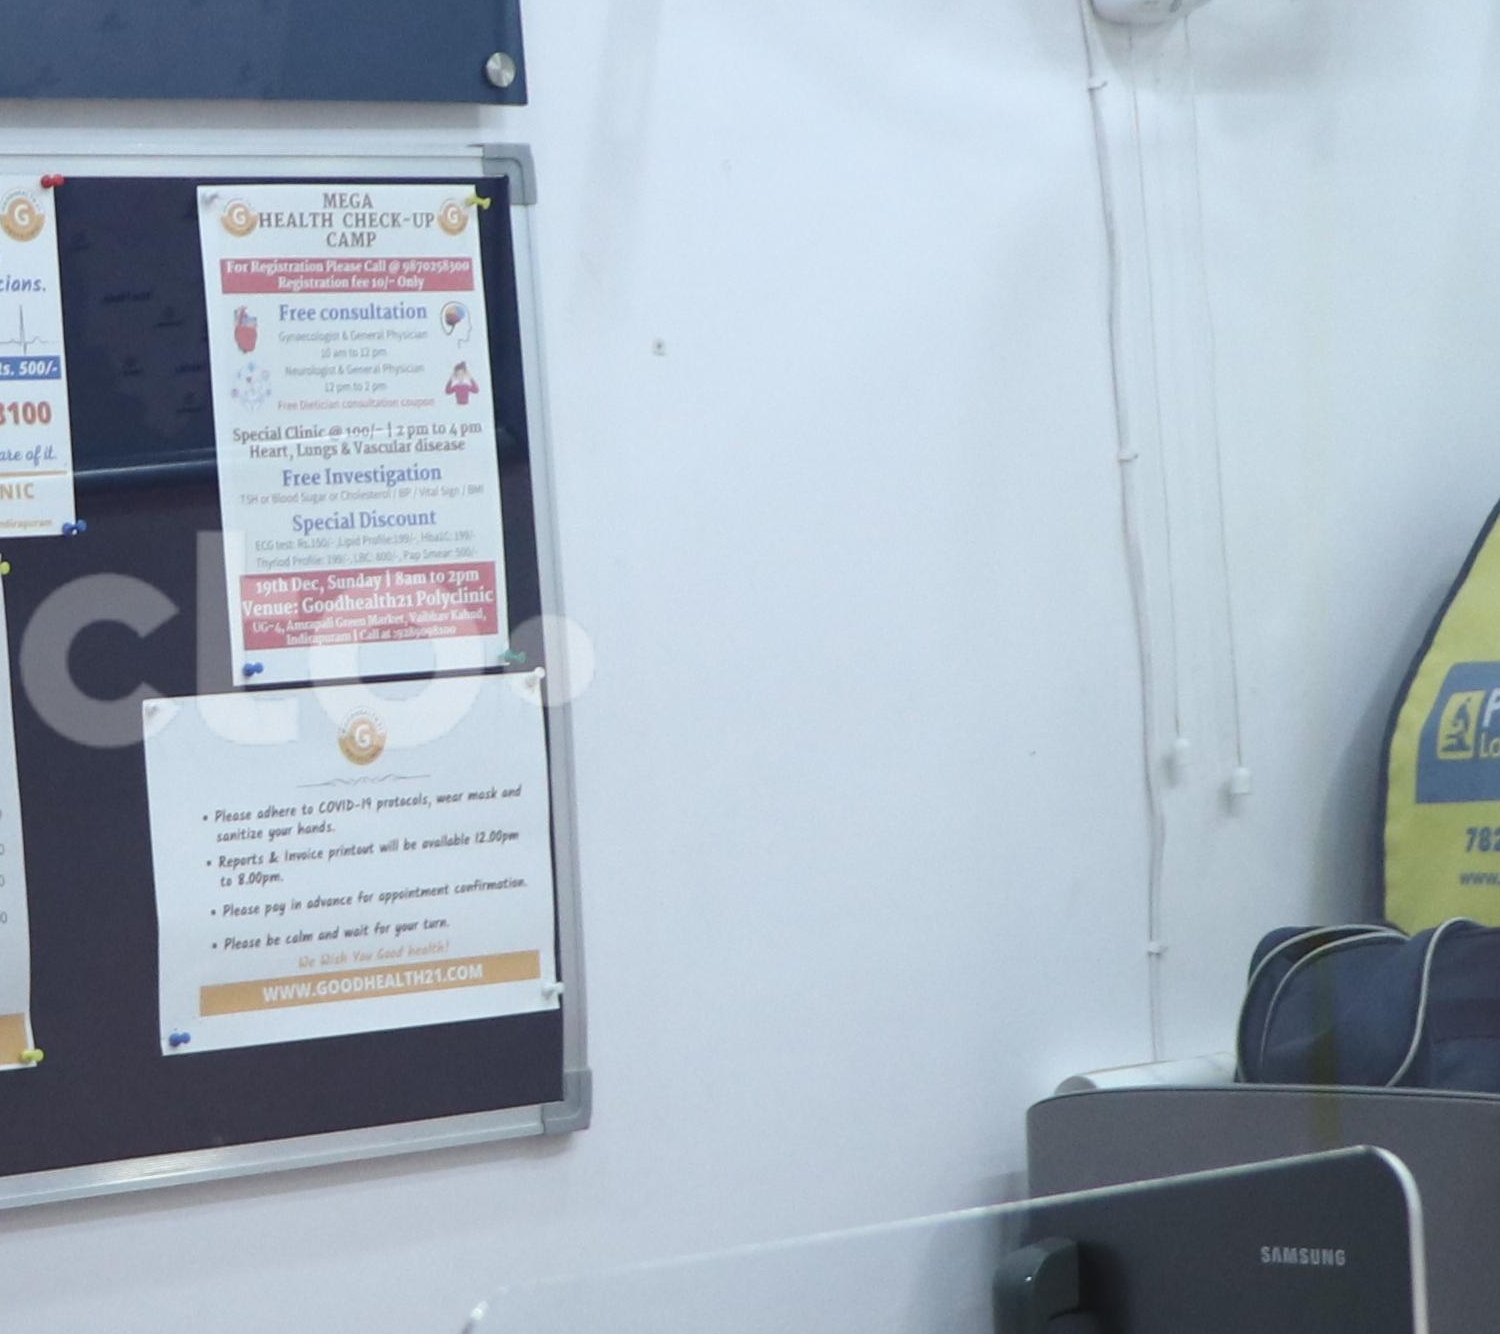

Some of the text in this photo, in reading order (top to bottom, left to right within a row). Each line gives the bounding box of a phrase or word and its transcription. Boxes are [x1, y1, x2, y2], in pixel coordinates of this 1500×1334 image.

[322, 192, 374, 209] MEGA
[258, 212, 435, 228] HEALTH CHECK-UP
[326, 231, 377, 248] CAMP
[279, 301, 428, 321] Free consultation
[19, 360, 58, 375] 500/-
[249, 438, 466, 461] Heart, Lungs & Vascular disease
[282, 464, 442, 487] Free Investigation
[292, 509, 437, 536] Special Discount
[255, 569, 479, 596] 19th Dec, Sunday 8am to 2pm
[241, 585, 494, 617] Venue: Goodhealth21 Polyclinic
[262, 963, 484, 1003] WWW.GOODHEALTH21.COM
[1260, 1246, 1346, 1267] SAMSUNG
